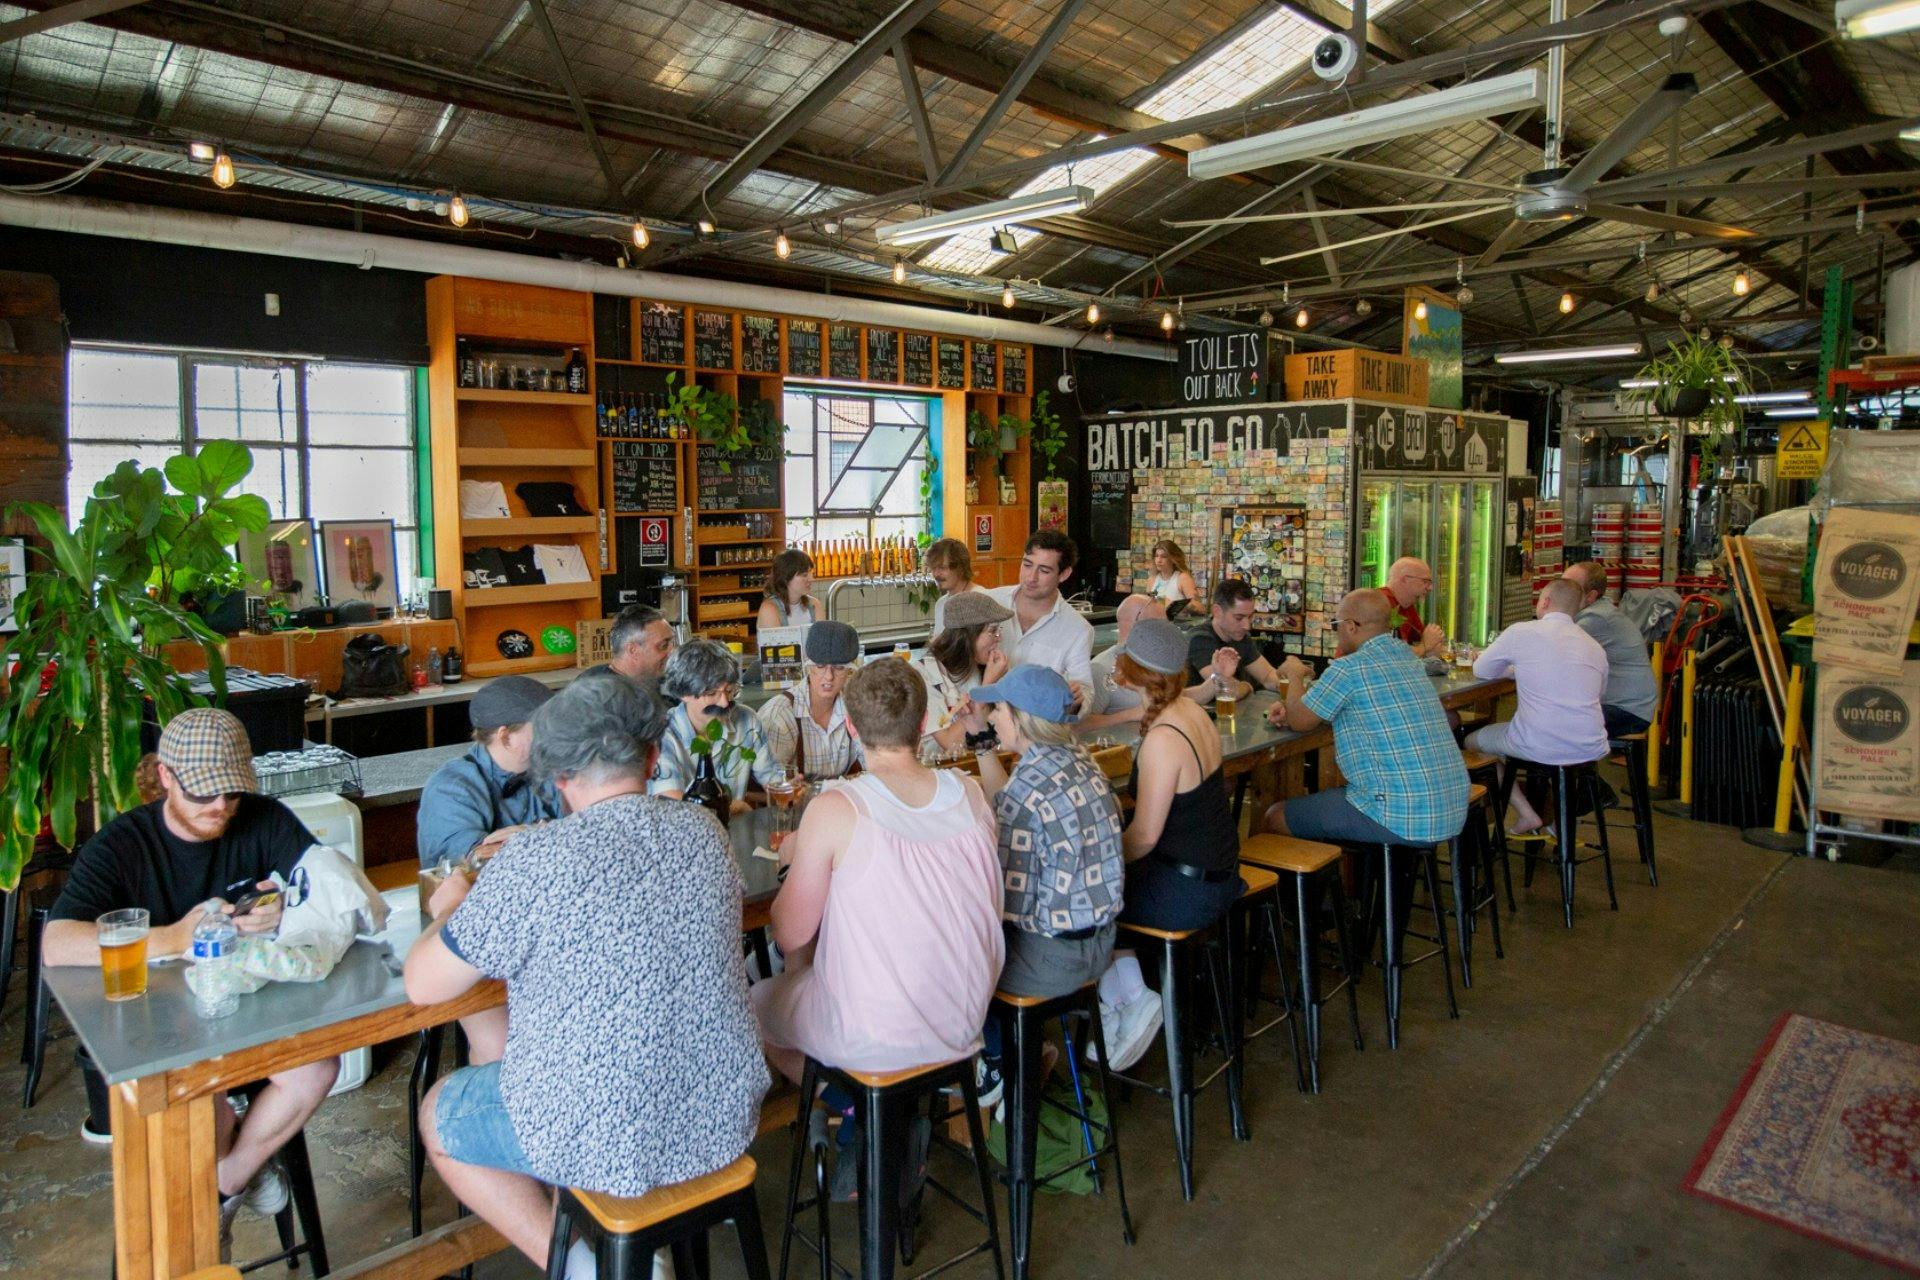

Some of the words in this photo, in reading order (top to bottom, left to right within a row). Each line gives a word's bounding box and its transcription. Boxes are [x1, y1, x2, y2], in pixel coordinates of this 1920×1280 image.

[1186, 333, 1259, 372] TOILETS
[1306, 355, 1336, 375] TAKE
[1184, 374, 1211, 401] OUT
[1215, 371, 1243, 398] BACK
[1360, 357, 1382, 391] TAKE
[1386, 361, 1411, 395] AWAY
[1303, 379, 1338, 399] AWAY
[1380, 417, 1394, 446] WE
[1406, 413, 1426, 450] BREW
[631, 443, 644, 456] ON
[650, 443, 671, 457] TAP
[1088, 420, 1168, 471] BATCH
[1181, 416, 1214, 468] TO
[1227, 414, 1262, 466] GO
[1840, 561, 1899, 581] VOYAGER
[1833, 600, 1886, 615] SCHOONER
[1847, 610, 1871, 620] PALE
[1841, 706, 1902, 723] VOYAGER
[1844, 747, 1898, 758] SCHOONER
[1860, 756, 1884, 764] PALE
